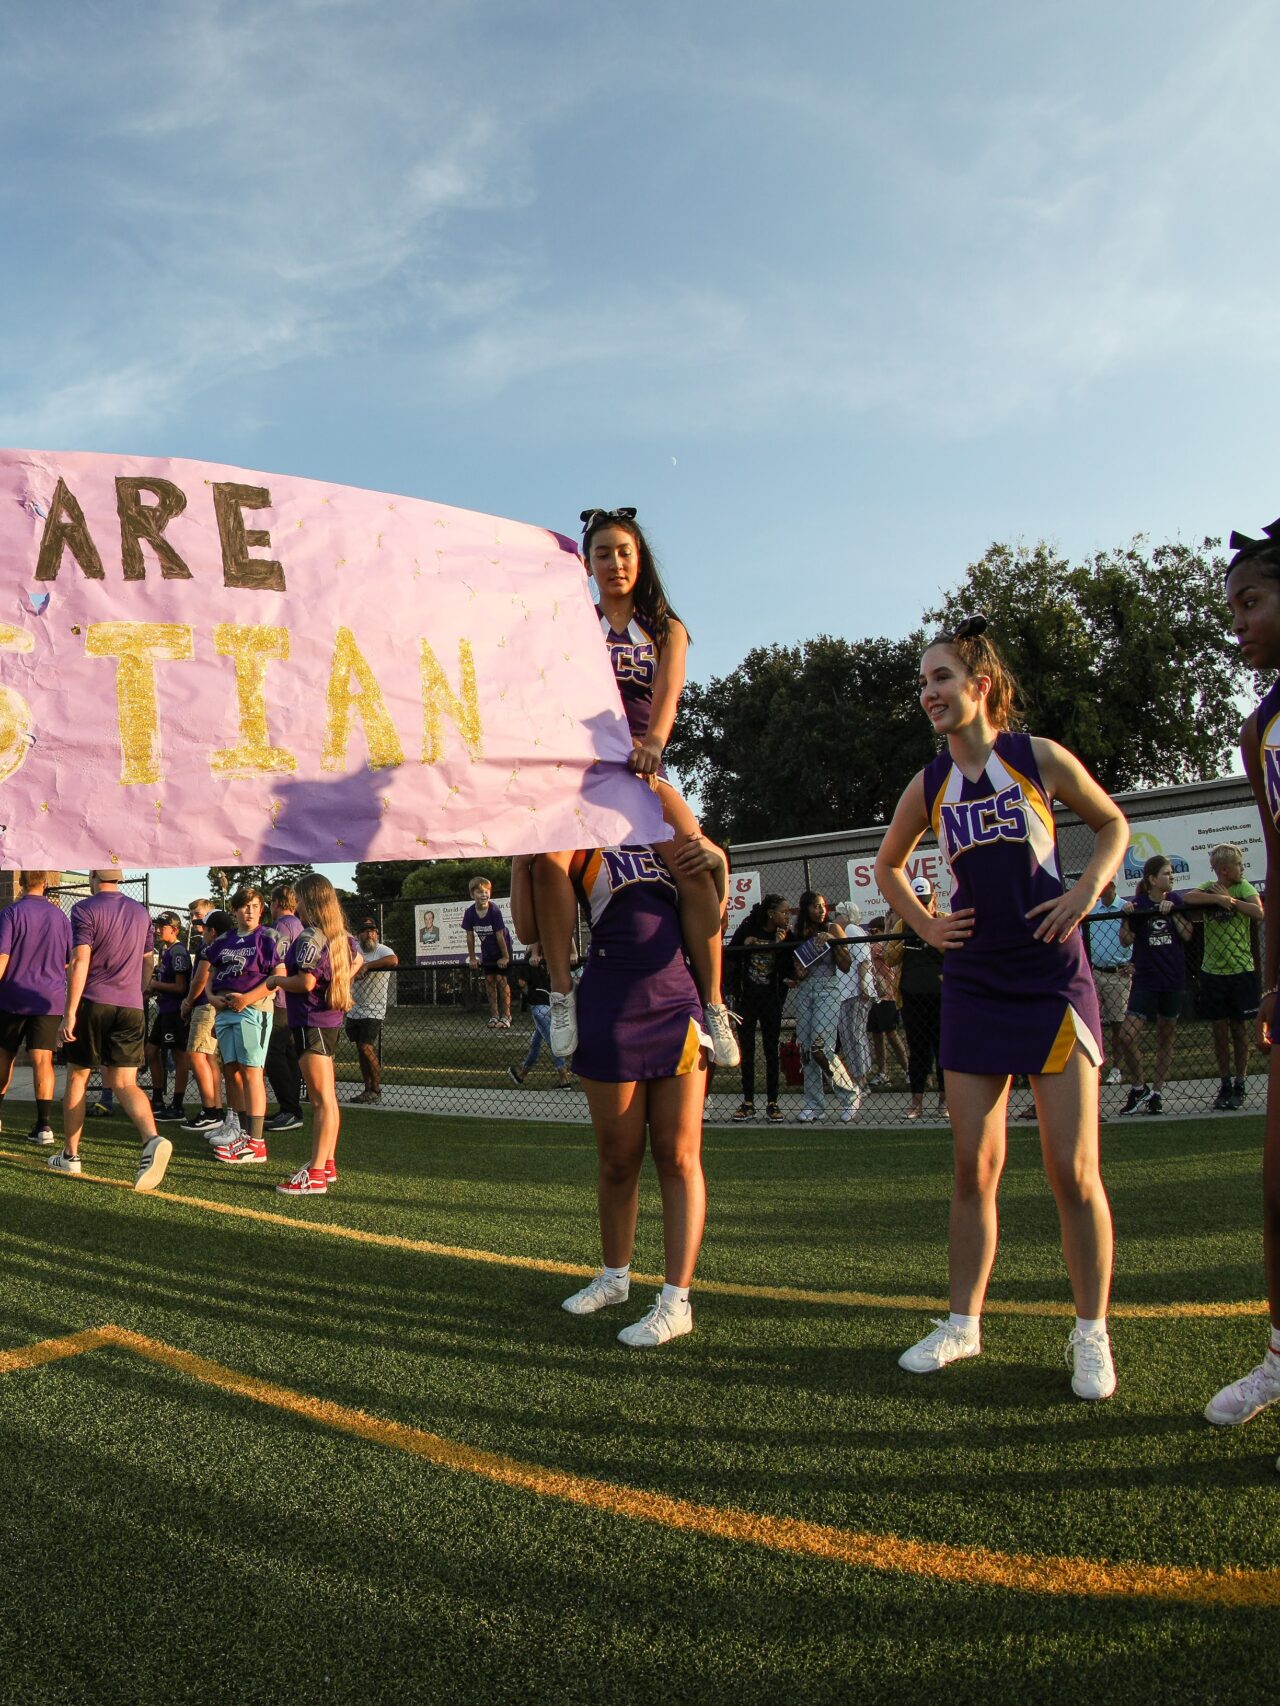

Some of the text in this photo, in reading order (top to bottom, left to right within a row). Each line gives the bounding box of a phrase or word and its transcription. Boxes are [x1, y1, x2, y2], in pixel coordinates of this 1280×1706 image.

[34, 475, 287, 592] ARE
[607, 642, 658, 687] CS
[939, 782, 1031, 863] NCS
[1190, 844, 1206, 852] 4340
[600, 850, 677, 894] NCS
[735, 878, 753, 893] &
[854, 855, 952, 888] SVE'
[442, 906, 459, 914] David
[296, 941, 317, 970] 60
